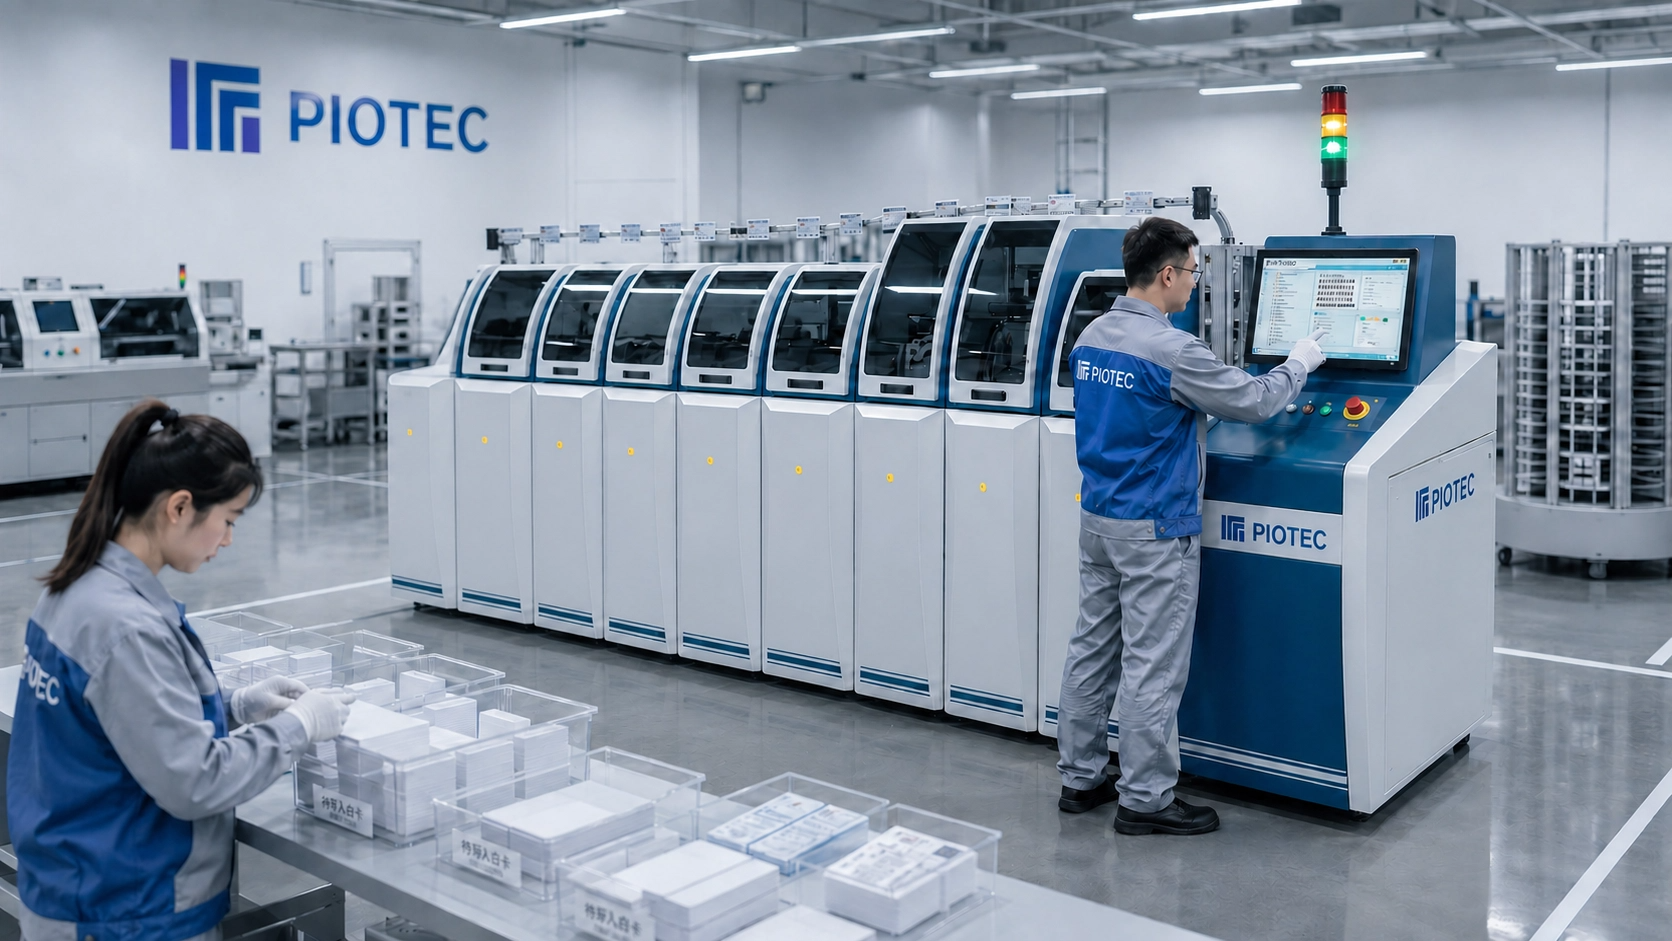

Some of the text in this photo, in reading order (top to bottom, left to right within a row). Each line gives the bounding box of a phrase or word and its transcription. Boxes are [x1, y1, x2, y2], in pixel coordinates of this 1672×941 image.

[290, 90, 489, 153] PIOTEC
[1091, 366, 1135, 389] PIOTEC
[1431, 473, 1475, 514] PIOTEC
[1252, 522, 1327, 551] PIOTEC
